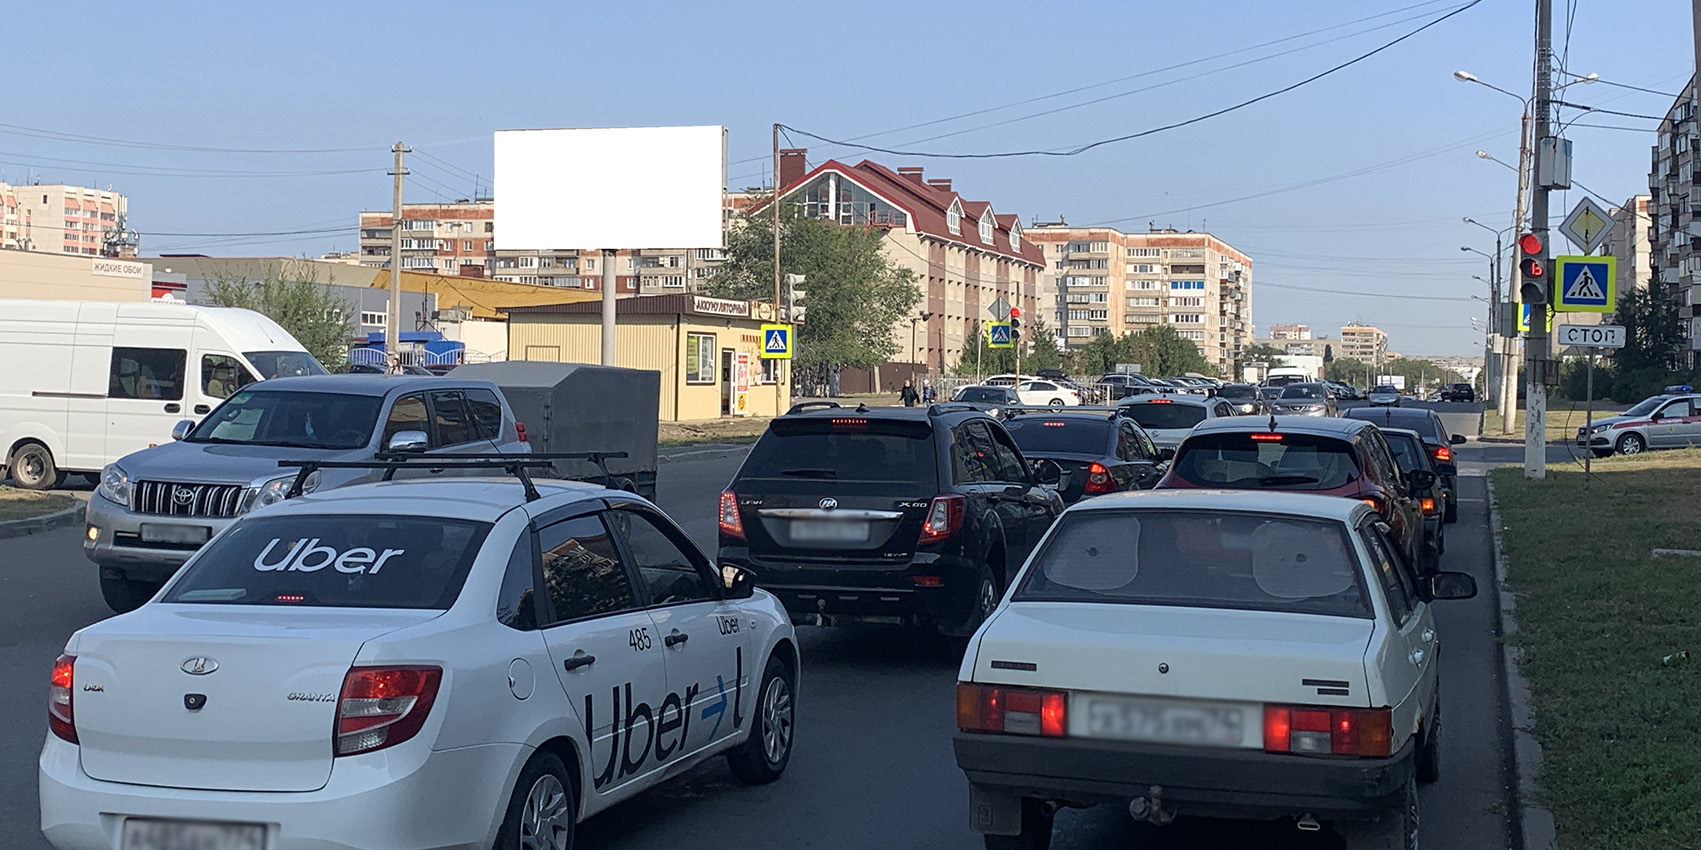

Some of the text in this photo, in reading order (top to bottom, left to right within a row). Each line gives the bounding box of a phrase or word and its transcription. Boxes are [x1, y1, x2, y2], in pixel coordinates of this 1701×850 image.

[93, 262, 142, 275] ЖИДКИЕ ОБОИ
[1567, 328, 1616, 343] СТОП
[253, 538, 406, 575] Uber
[715, 615, 740, 636] Uber
[628, 627, 652, 652] 485
[286, 690, 336, 704] GRANTA
[584, 681, 699, 791] Uber
